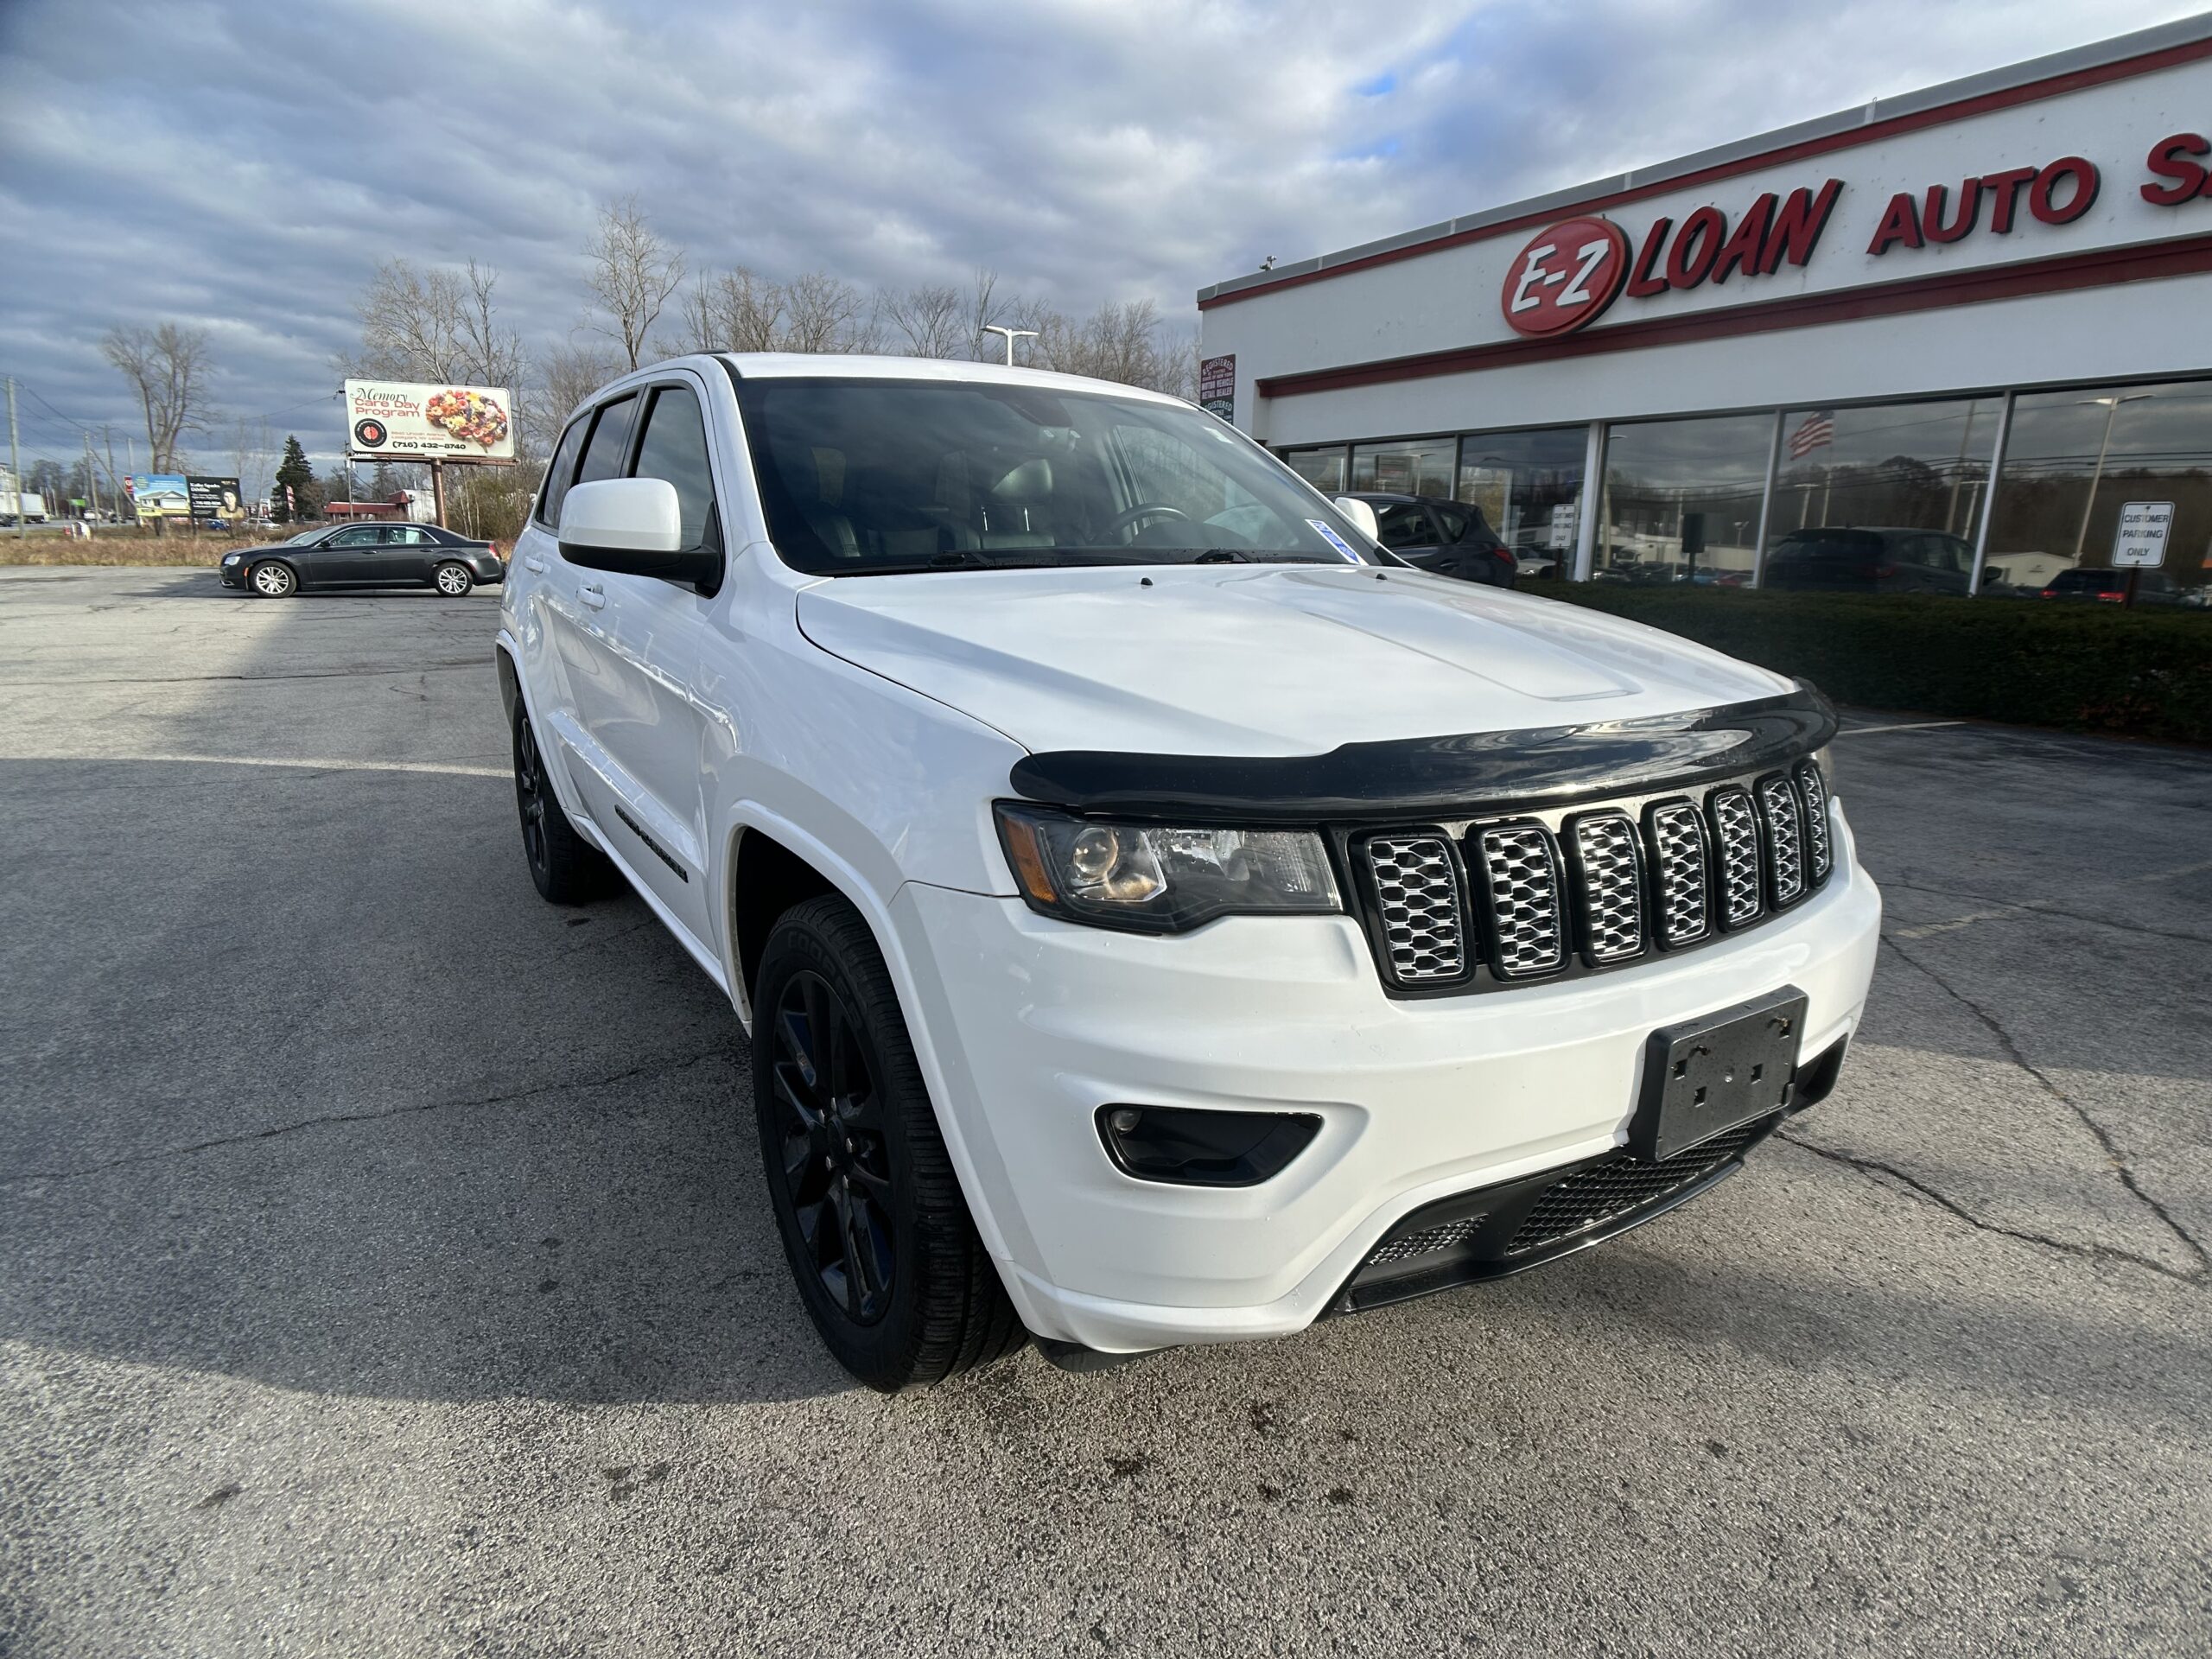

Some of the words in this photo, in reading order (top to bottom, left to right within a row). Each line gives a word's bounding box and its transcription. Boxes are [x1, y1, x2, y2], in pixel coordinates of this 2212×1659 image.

[1511, 238, 1609, 313] E-Z
[1626, 178, 1846, 297] LOAN
[1866, 156, 2101, 255] AUTO
[2140, 132, 2212, 206] S
[1202, 358, 1234, 376] REGISTERED
[1217, 377, 1234, 388] VEHICLE
[350, 387, 408, 404] Memory
[1216, 386, 1233, 397] DEALER
[354, 397, 390, 408] Care
[394, 400, 420, 411] Day
[355, 406, 421, 418] Program
[2124, 514, 2170, 523] CUSTOMER
[2122, 529, 2164, 538] PARKING
[2127, 547, 2151, 556] ONLY
